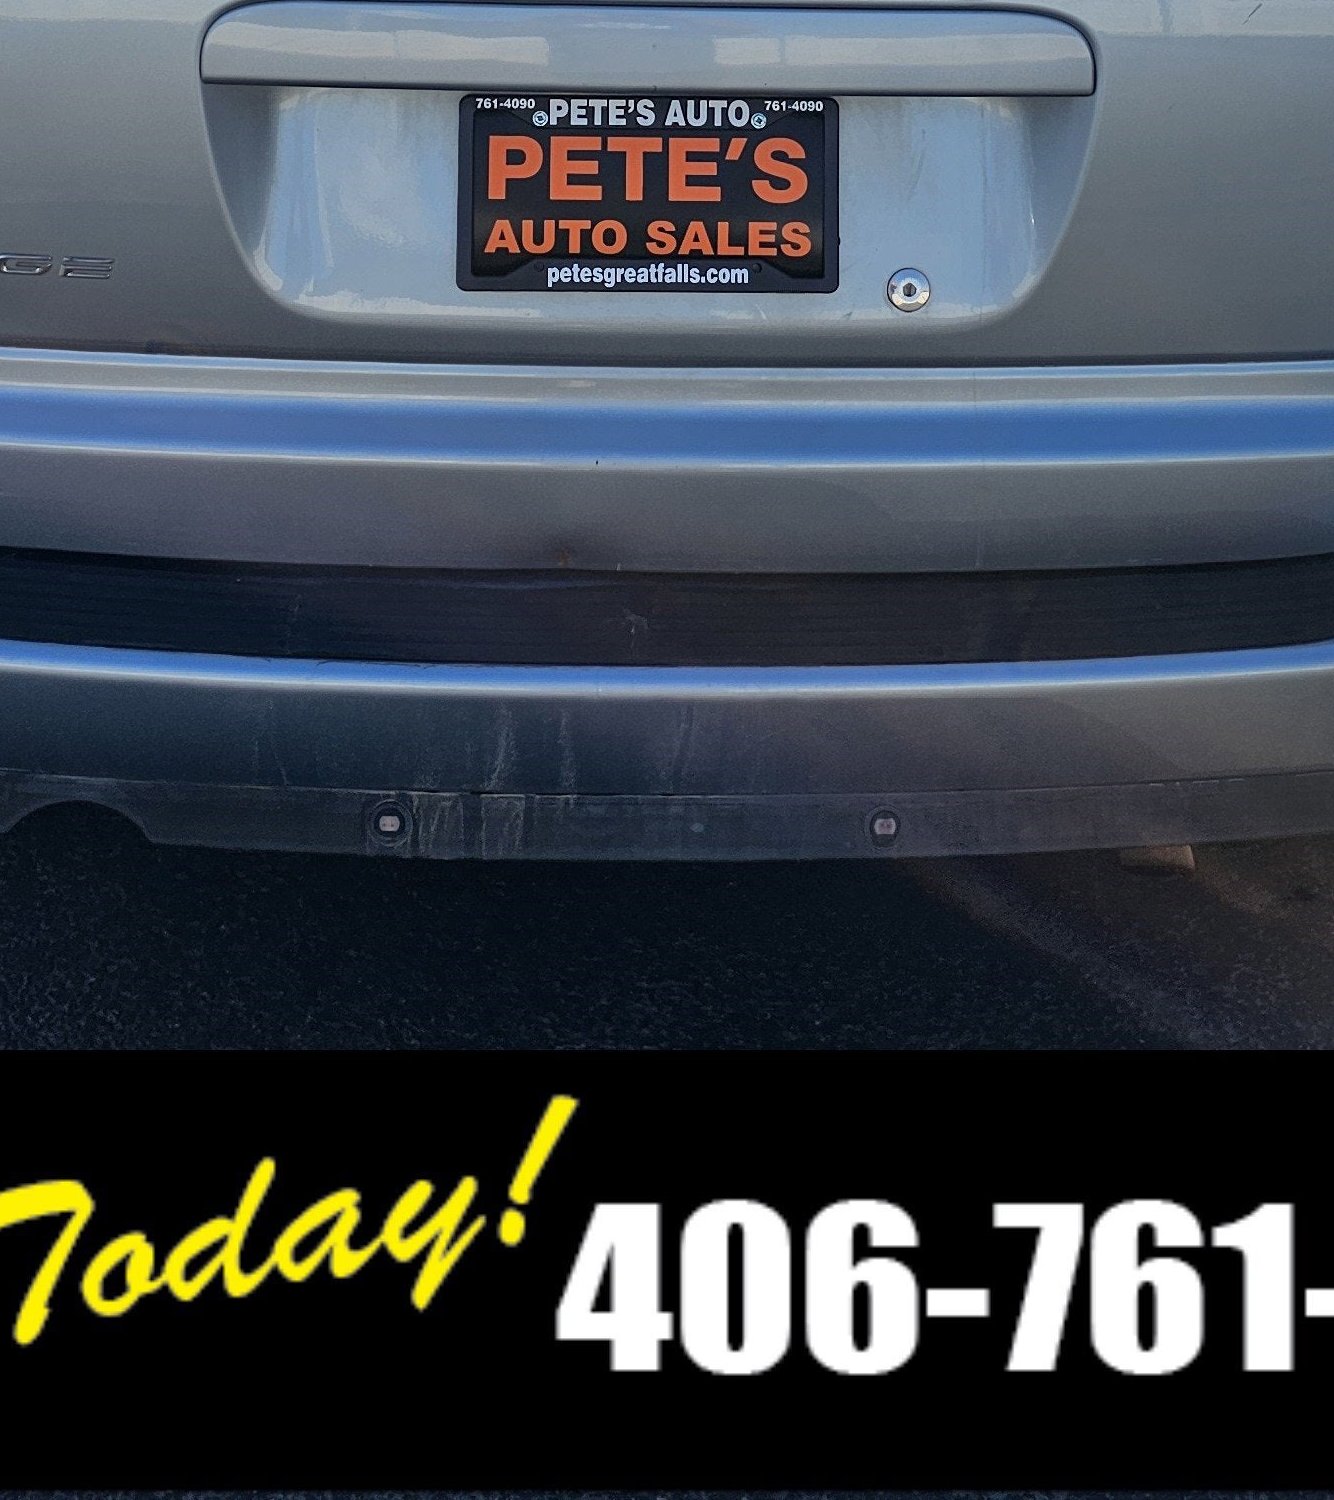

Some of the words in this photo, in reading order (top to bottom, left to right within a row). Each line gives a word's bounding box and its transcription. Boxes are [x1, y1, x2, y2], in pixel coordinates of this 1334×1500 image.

[475, 97, 536, 109] 761-4090
[548, 97, 656, 127] PETE'S
[664, 99, 750, 128] AUTO
[764, 100, 824, 112] 761-4090
[487, 135, 809, 204] PETE'S
[483, 219, 628, 255] AUTO
[645, 220, 812, 258] SALES
[547, 262, 749, 288] petesgreatfalls.com
